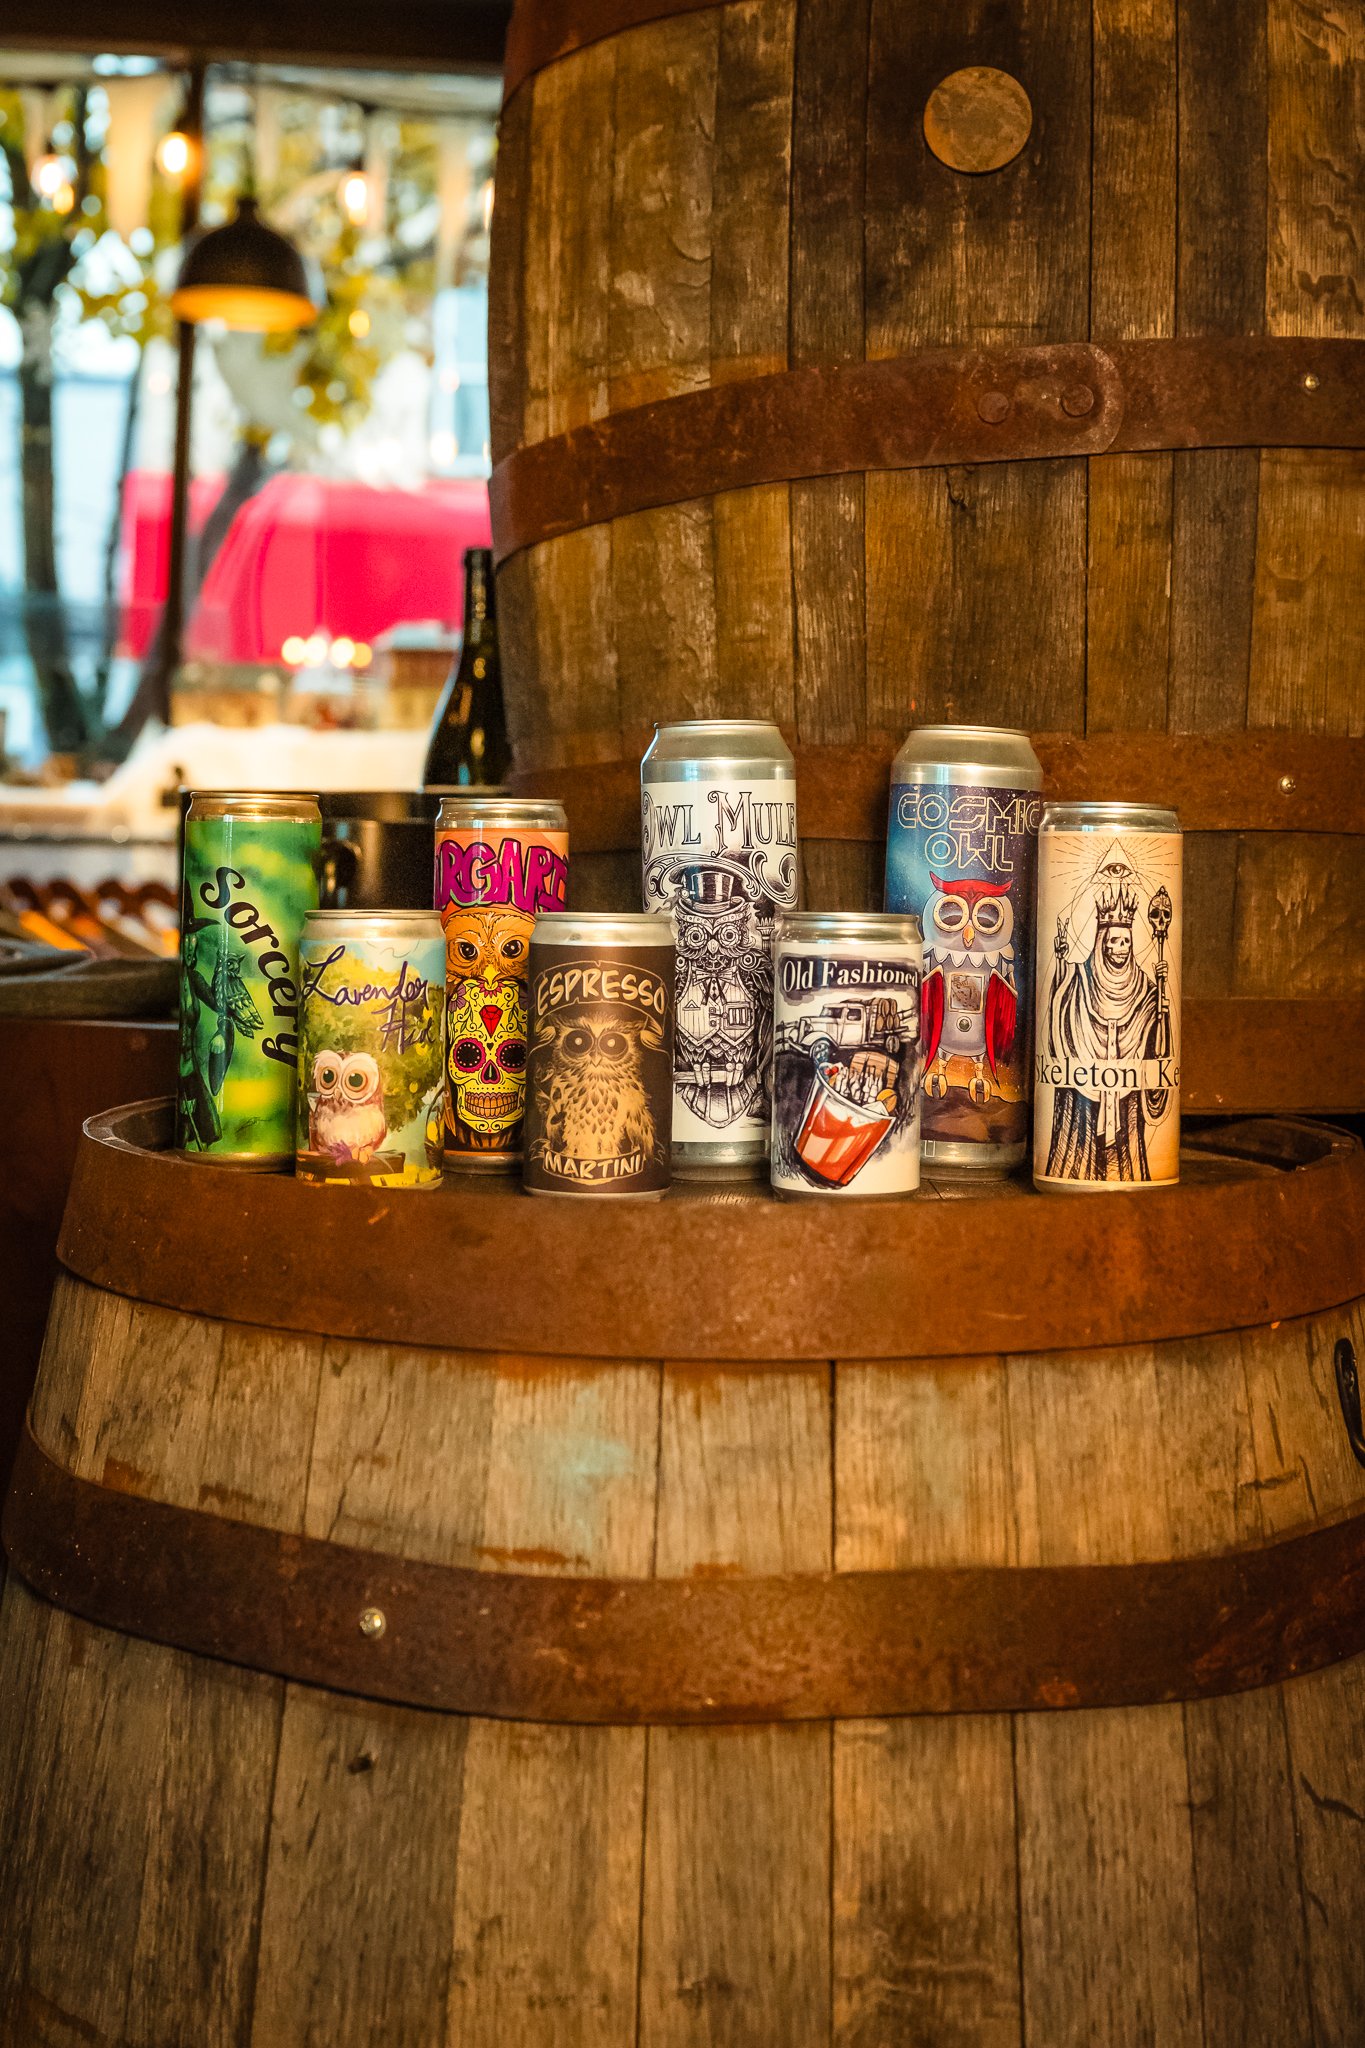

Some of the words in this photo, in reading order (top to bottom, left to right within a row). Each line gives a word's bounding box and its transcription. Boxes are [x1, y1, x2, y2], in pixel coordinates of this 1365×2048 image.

[707, 790, 797, 858] MULE
[897, 792, 1040, 836] COSMIC
[924, 831, 1014, 872] OWL
[199, 866, 299, 1069] Sorcery
[302, 944, 430, 1011] Lavender
[783, 960, 814, 993] Old
[820, 960, 918, 988] Fashioned
[537, 968, 666, 1016] ESPRESSO
[1156, 1059, 1180, 1088] Ke
[545, 1150, 641, 1179] MARTINI
